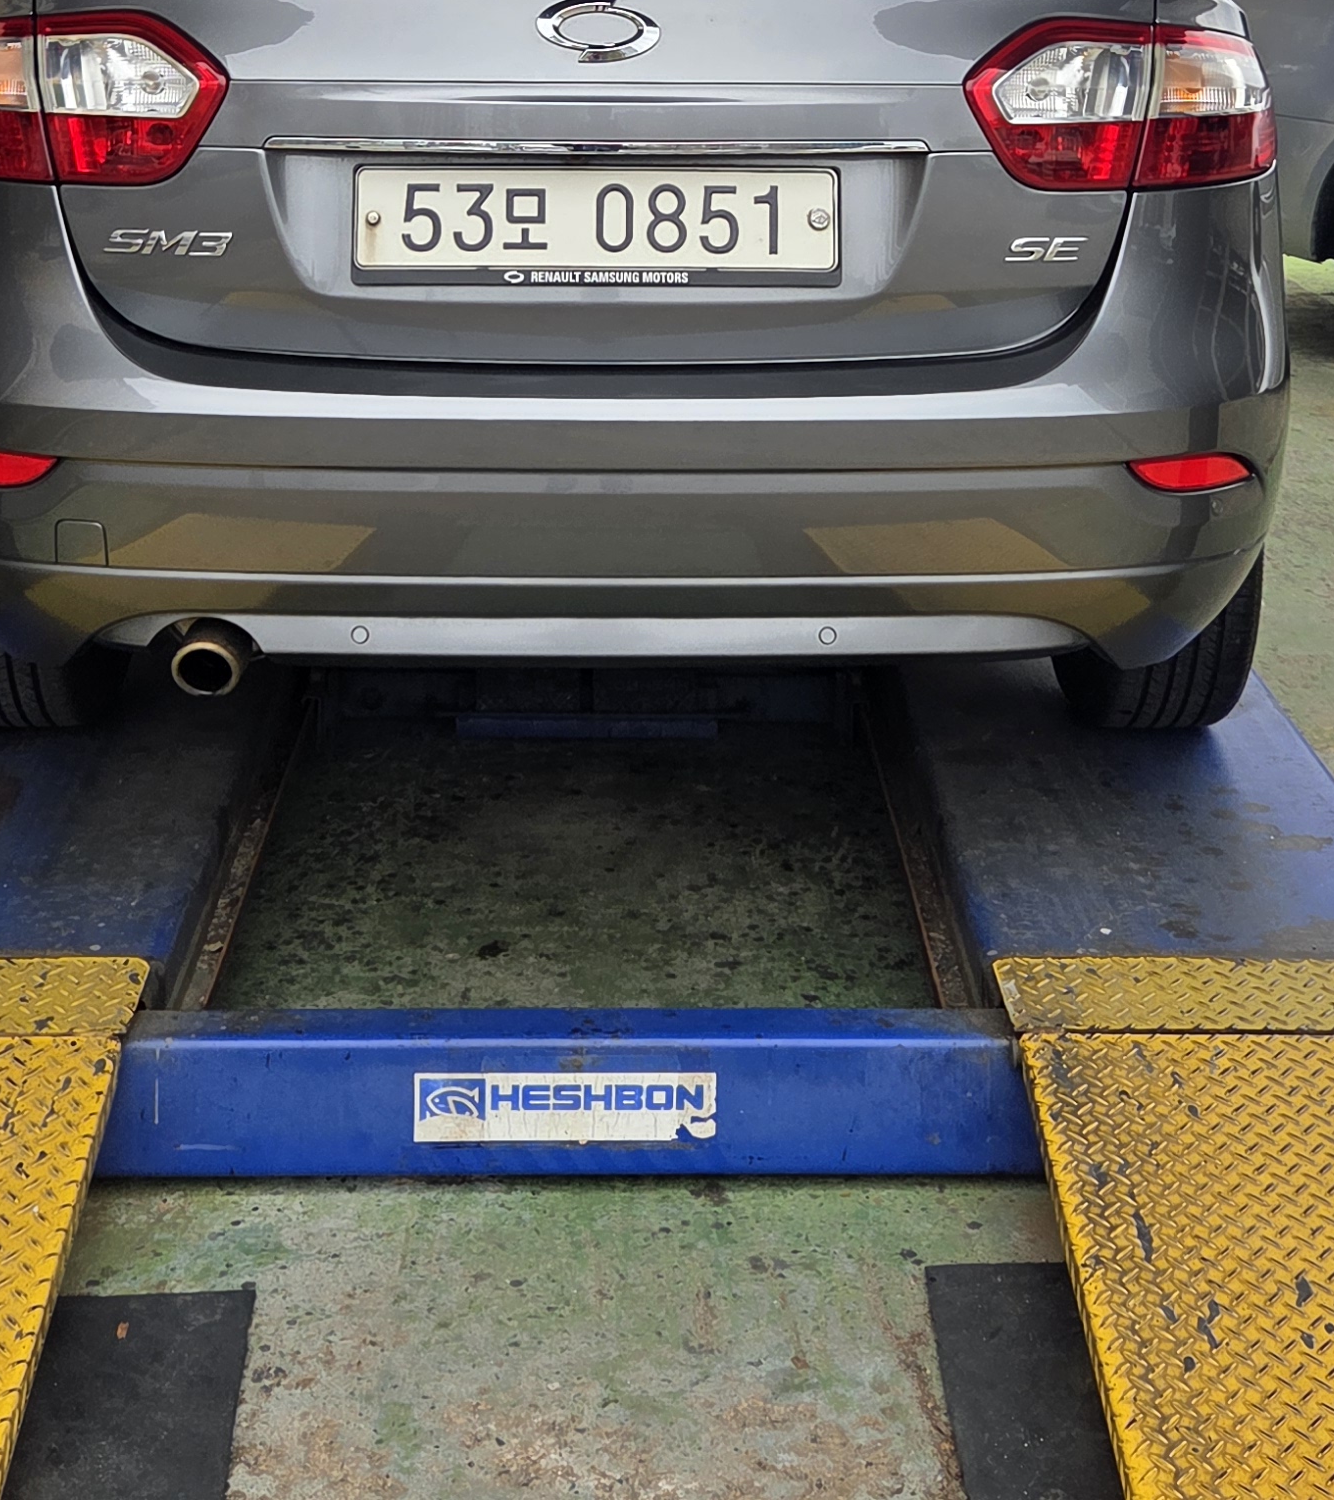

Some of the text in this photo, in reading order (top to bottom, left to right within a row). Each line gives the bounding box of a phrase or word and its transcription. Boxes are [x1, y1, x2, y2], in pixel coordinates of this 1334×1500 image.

[399, 182, 781, 256] 53모 0851
[101, 227, 234, 257] SM3
[1002, 235, 1090, 264] SE
[530, 271, 689, 283] RENAULT SAMSUNG MOTORS
[491, 1084, 704, 1111] HESHBON
